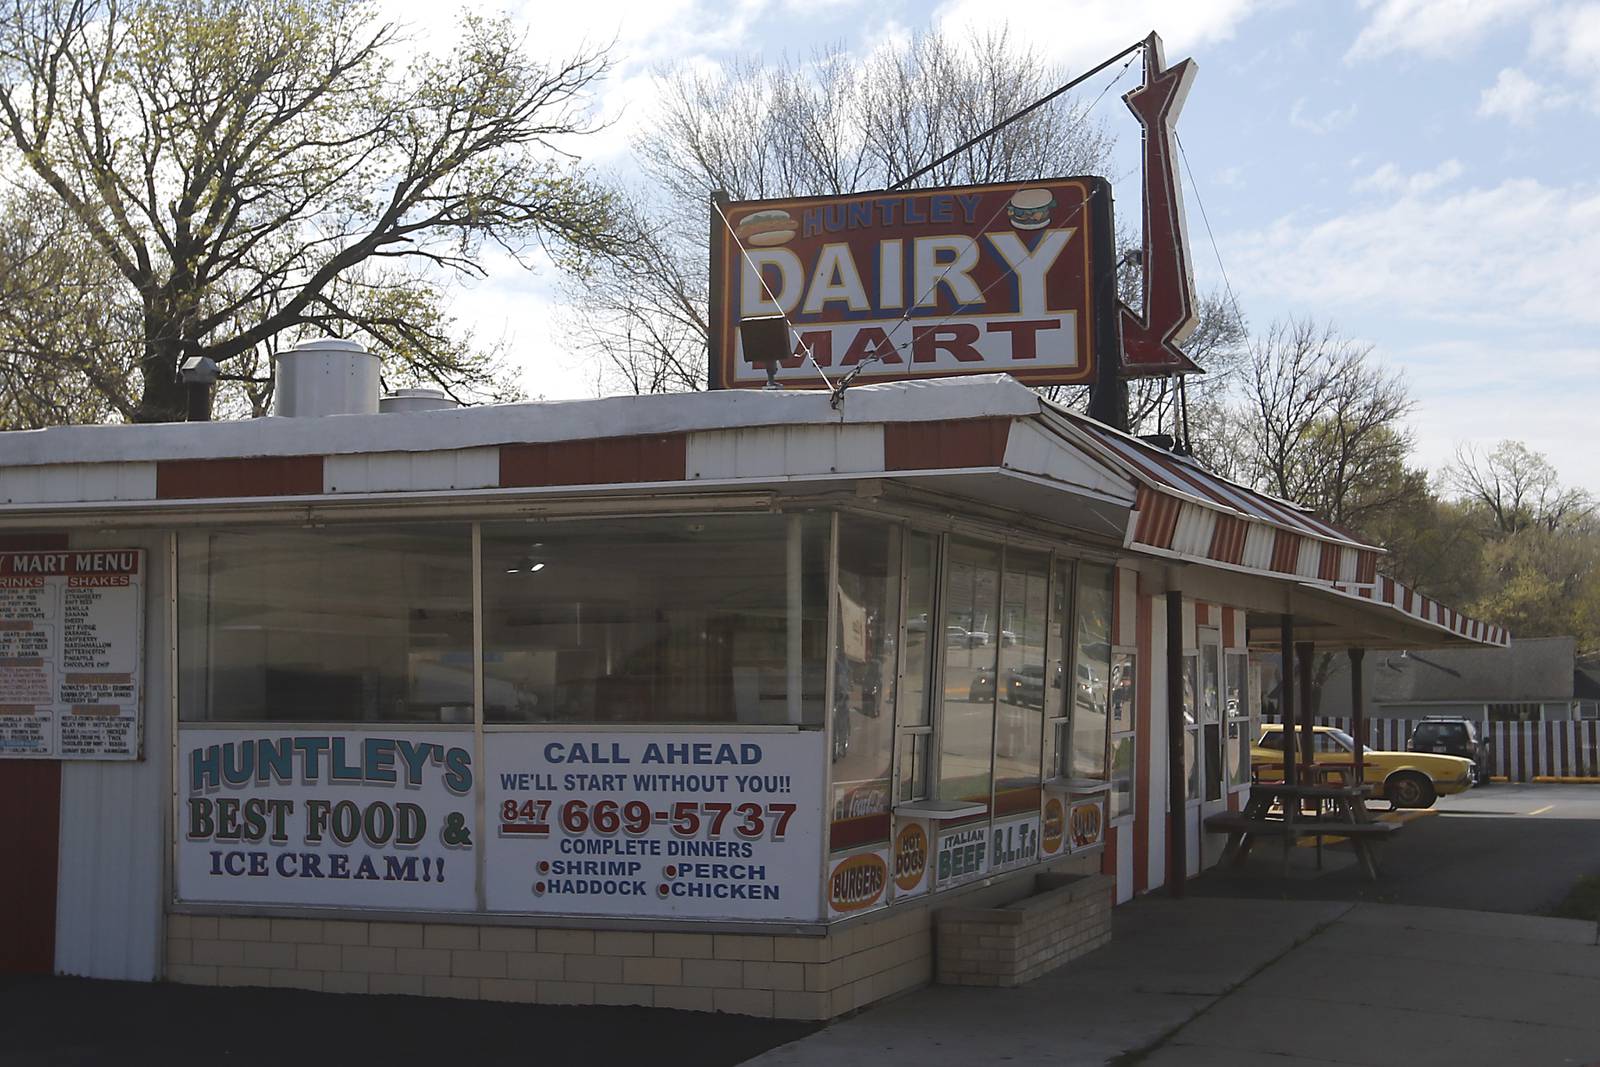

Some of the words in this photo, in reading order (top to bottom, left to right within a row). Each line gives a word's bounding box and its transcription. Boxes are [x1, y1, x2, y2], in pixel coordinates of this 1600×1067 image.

[802, 194, 982, 238] HUNTLEY
[740, 227, 1077, 317] DAIRY
[751, 319, 1061, 370] MART
[14, 555, 69, 572] MART
[76, 553, 133, 571] MENU
[70, 576, 128, 586] SHAKES
[190, 736, 473, 794] HUNTLEY'S
[544, 743, 630, 764] CALL
[641, 743, 762, 765] AHEAD
[500, 773, 558, 791] WE'LL
[564, 774, 627, 792] START
[633, 774, 729, 793] WITHOUT
[735, 775, 791, 793] YOU!!
[188, 798, 293, 843] BEST
[305, 800, 427, 846] FOOD
[442, 812, 473, 847] &
[501, 799, 552, 821] 847
[560, 800, 797, 841] 669-5737
[560, 838, 661, 856] COMPLETE
[667, 840, 753, 858] DINNERS
[901, 831, 921, 853] HOT
[944, 830, 984, 849] ITALIAN
[210, 851, 269, 876] ICE
[276, 852, 445, 883] CREAM!!
[551, 860, 641, 876] SHRIMP
[678, 863, 766, 881] PERCH
[895, 852, 923, 879] DOGS
[938, 842, 986, 881] BEEF
[547, 880, 647, 896] HADDOCK
[671, 882, 780, 900] CHICKEN
[833, 863, 882, 902] BURGERS
